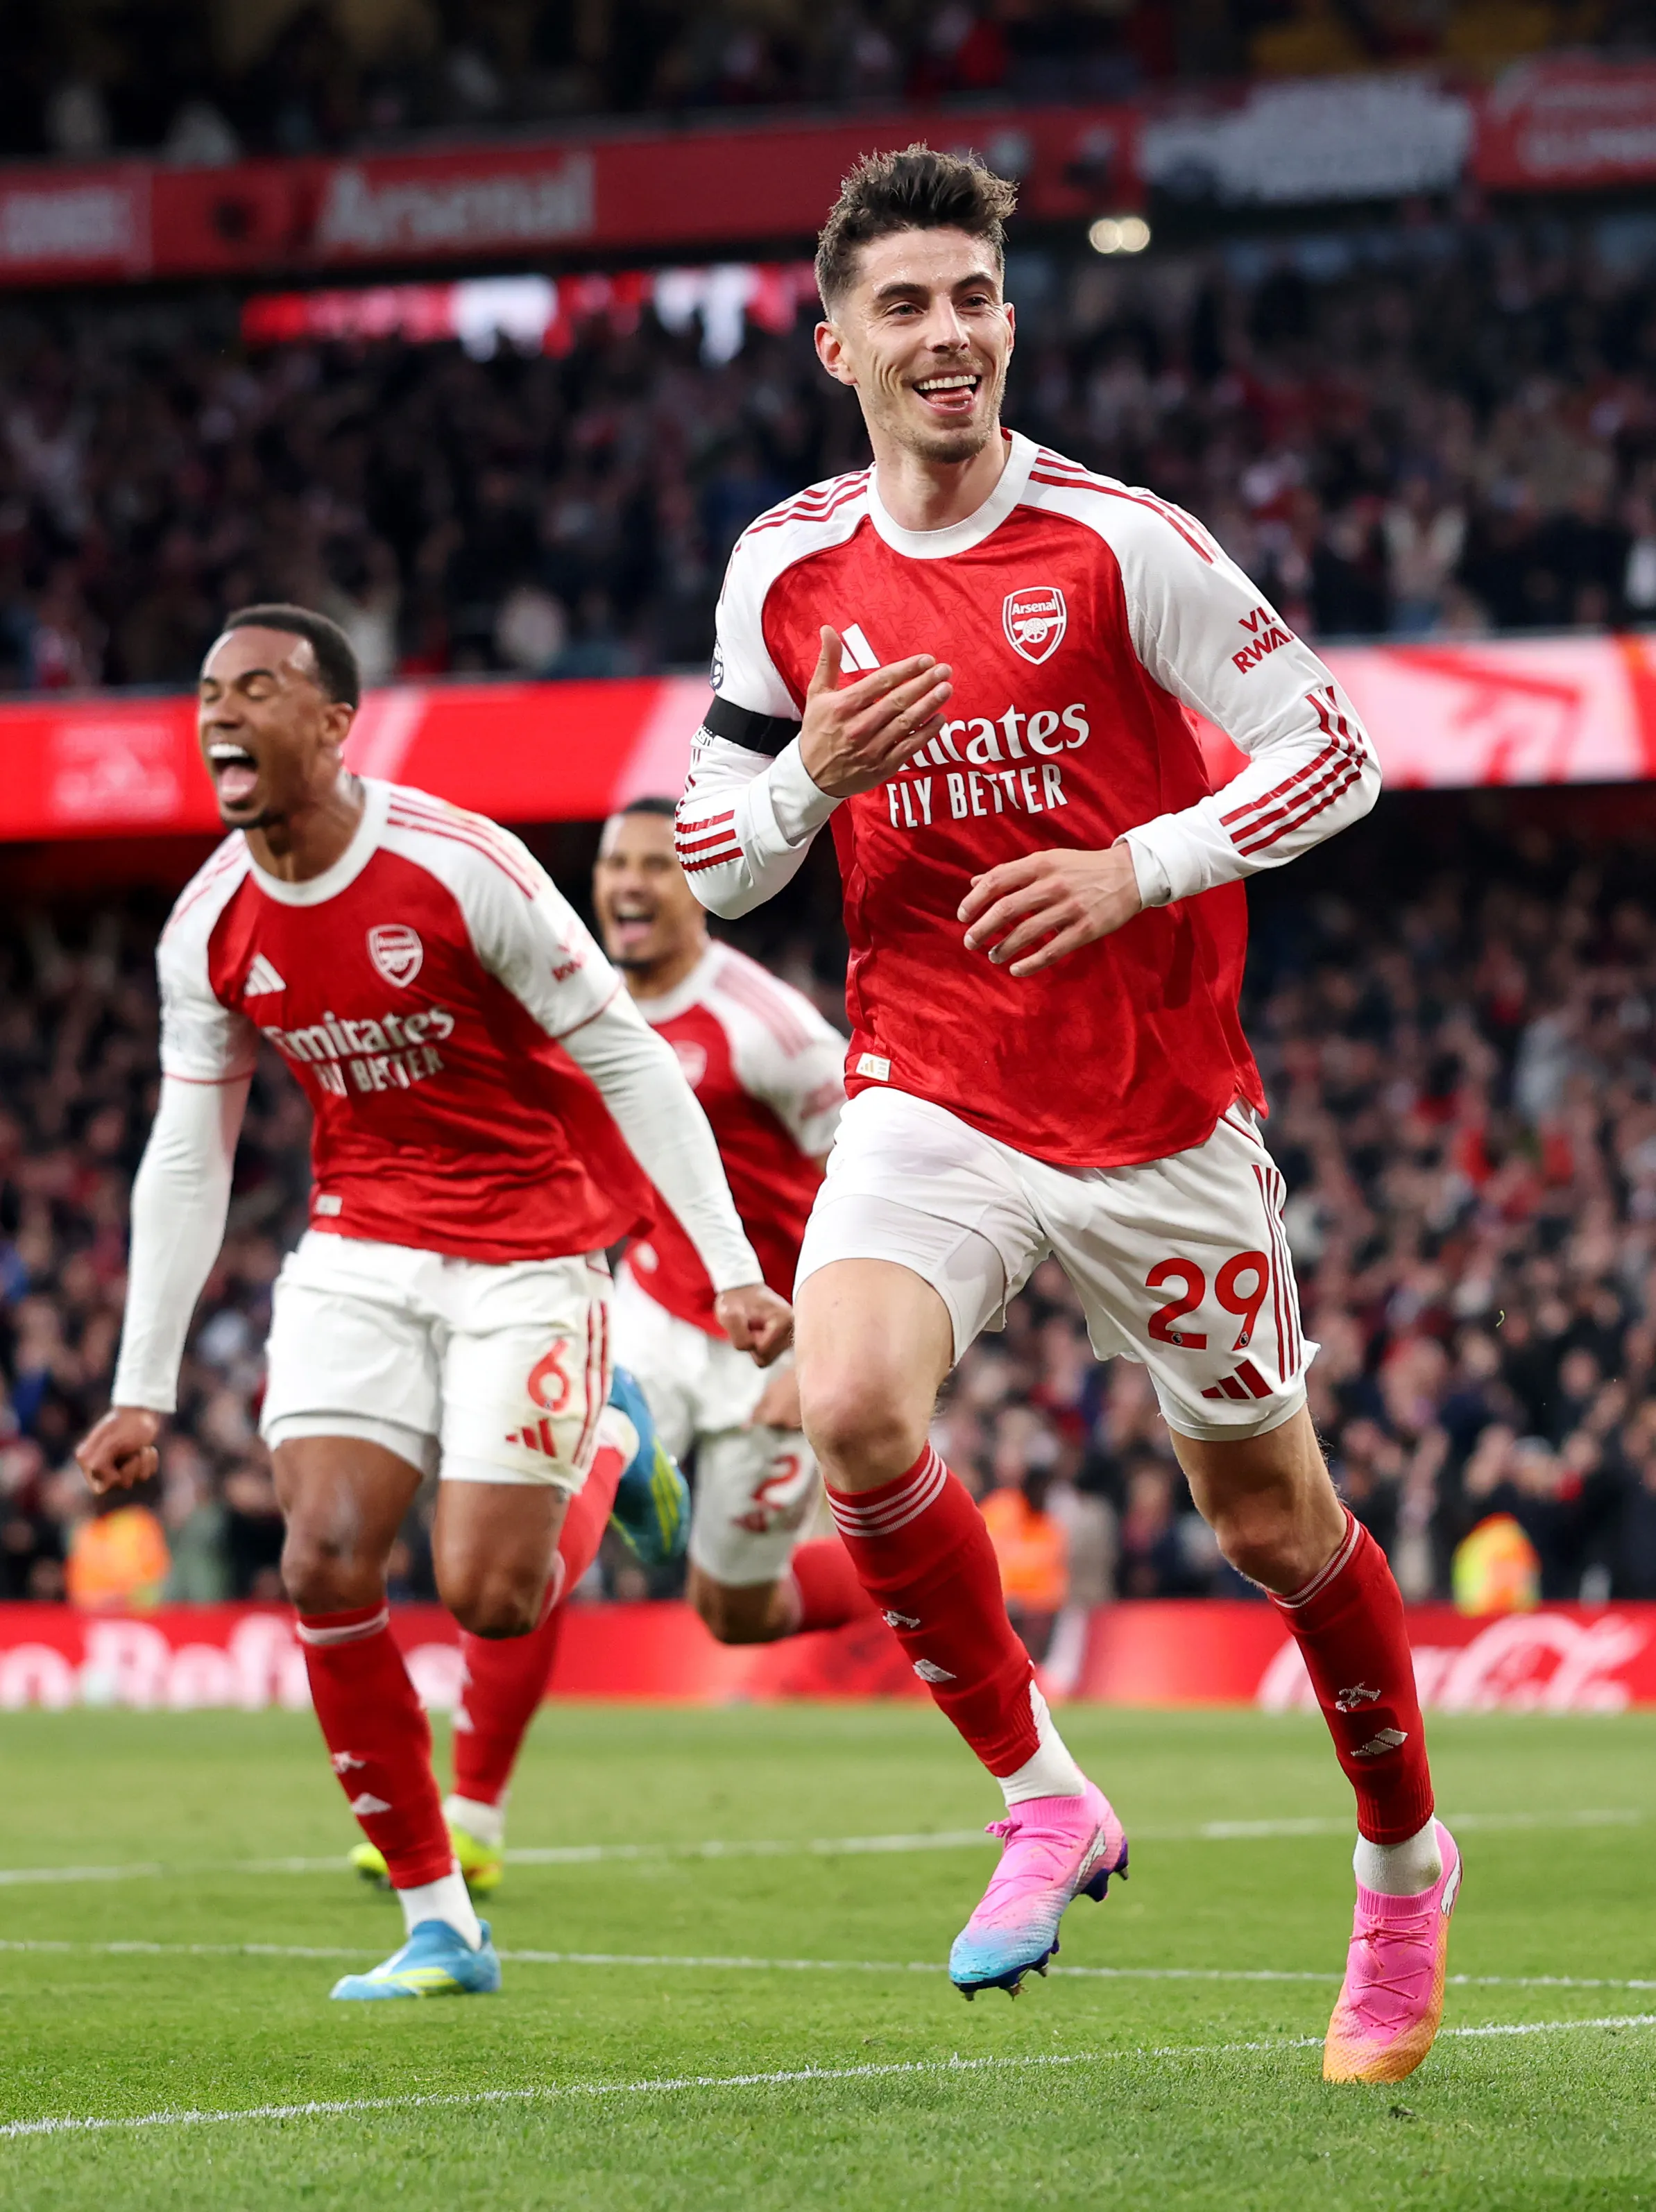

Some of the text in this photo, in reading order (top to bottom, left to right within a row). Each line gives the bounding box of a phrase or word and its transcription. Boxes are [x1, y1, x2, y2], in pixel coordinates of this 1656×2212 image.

[1011, 598, 1057, 616] Arsenal
[897, 703, 1091, 772] irates
[886, 764, 1068, 828] FLY BETTER
[1145, 1251, 1270, 1351] 29
[527, 1337, 570, 1412] 6
